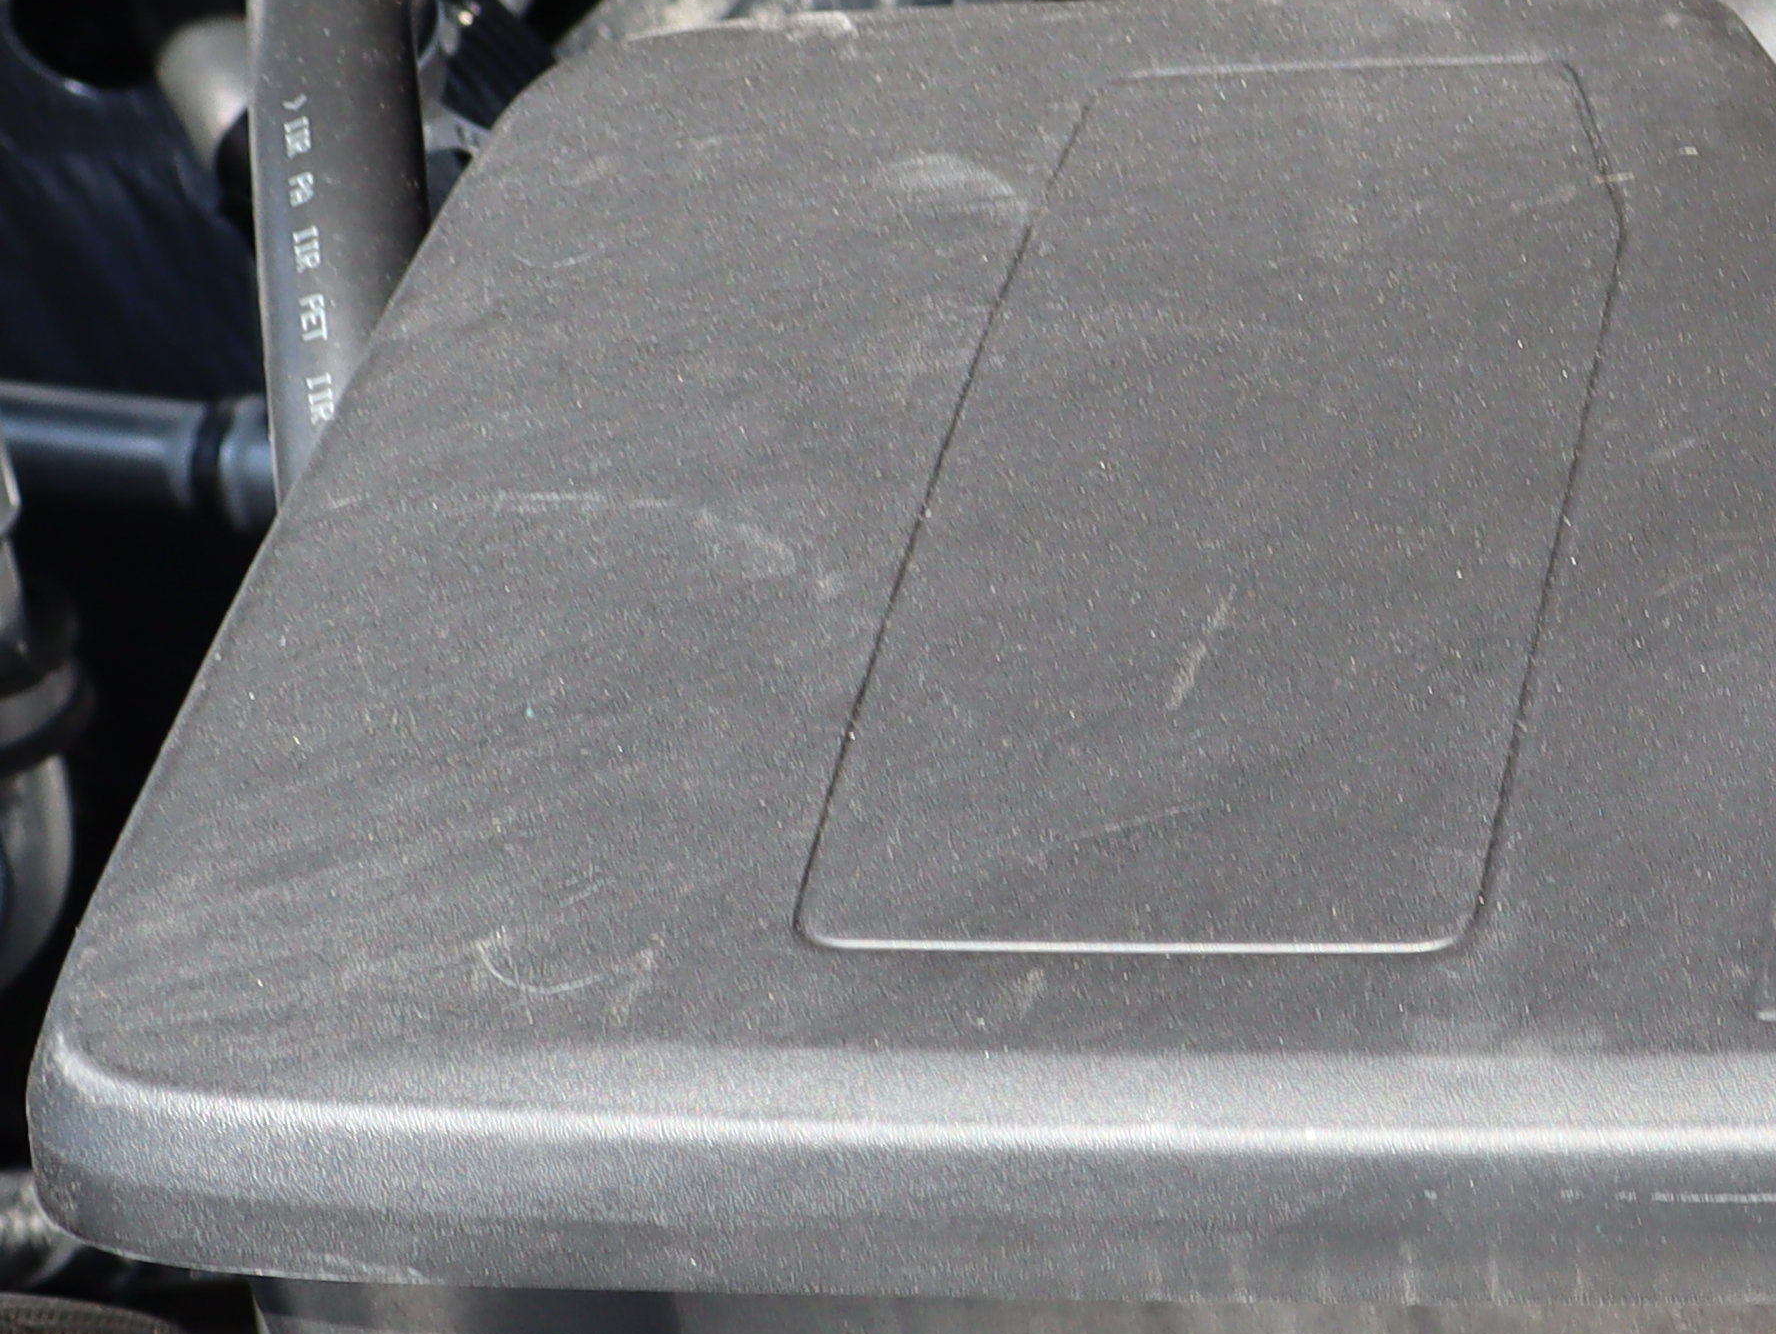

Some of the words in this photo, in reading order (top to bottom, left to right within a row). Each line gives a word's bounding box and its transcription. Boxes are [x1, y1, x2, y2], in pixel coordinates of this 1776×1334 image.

[292, 225, 321, 273] IIR
[299, 293, 328, 341] PET
[306, 372, 334, 425] IIR
